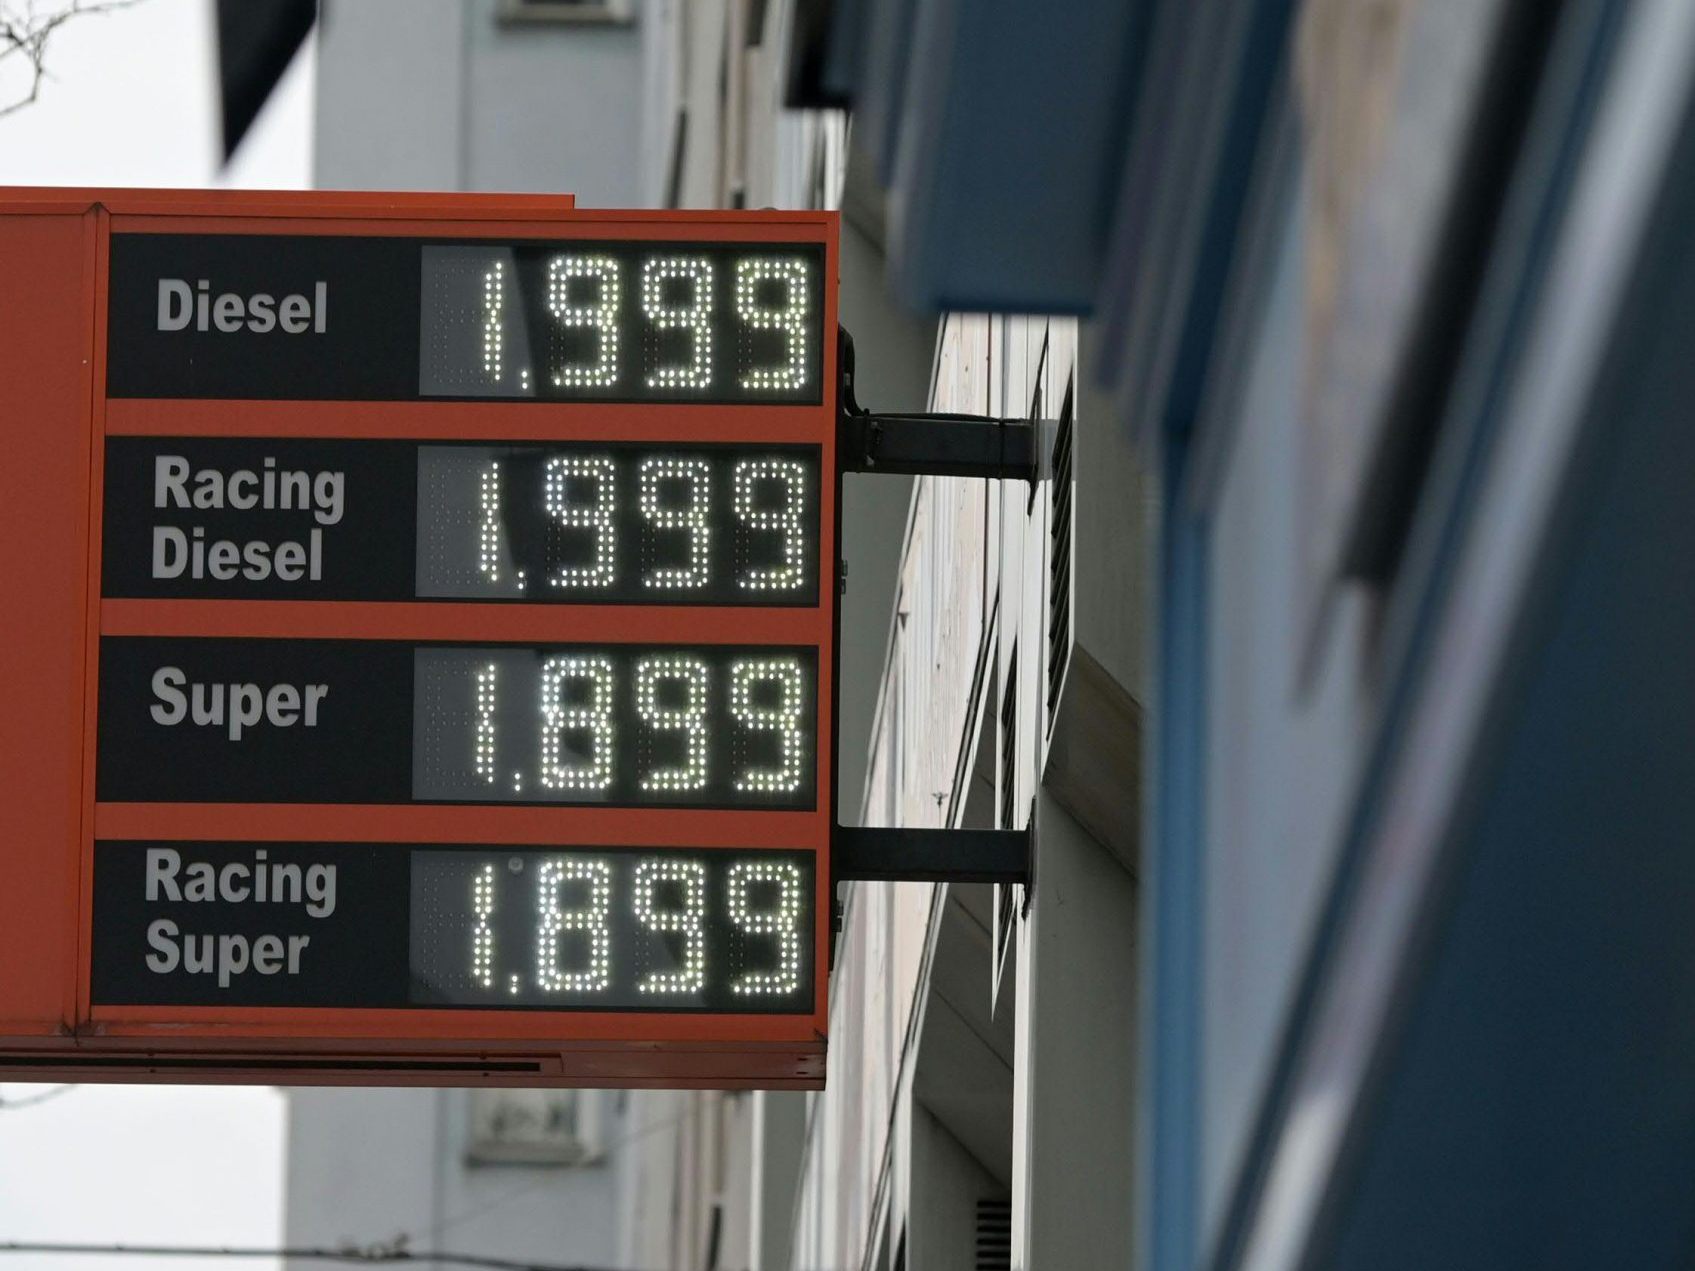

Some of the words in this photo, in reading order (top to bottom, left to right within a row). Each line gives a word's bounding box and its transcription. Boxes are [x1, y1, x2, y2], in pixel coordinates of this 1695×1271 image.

[157, 278, 328, 334] Diesel
[482, 256, 809, 391] 1.999
[153, 455, 346, 526] Racing
[478, 457, 805, 591] 1.999
[151, 525, 323, 582] Diesel
[149, 666, 329, 741] Super
[474, 658, 803, 794] 1.899
[144, 848, 337, 919] Racing
[144, 918, 310, 988] Super
[470, 859, 801, 996] 1.899
